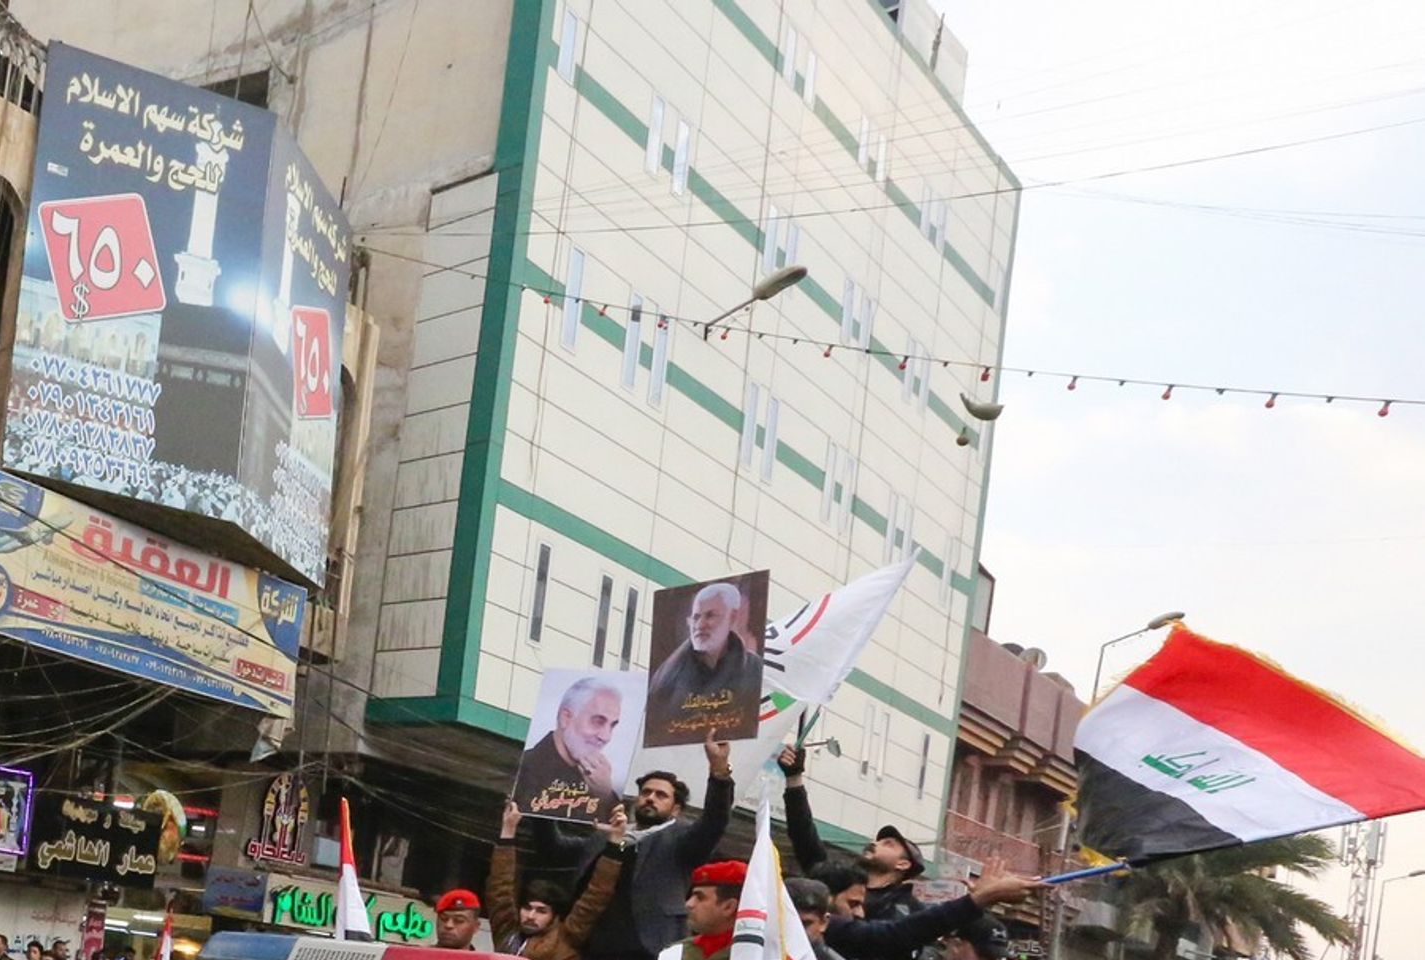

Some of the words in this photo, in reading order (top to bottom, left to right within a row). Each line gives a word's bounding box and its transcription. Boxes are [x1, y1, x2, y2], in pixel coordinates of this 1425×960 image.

[67, 72, 141, 117] الاسلام
[143, 103, 186, 132] سهم
[187, 103, 245, 152] شركة
[80, 120, 164, 182] والعمرة
[168, 158, 223, 192] للحج
[51, 211, 156, 291] ٦٥٠
[72, 281, 90, 322] $
[295, 315, 331, 396] ٦٥٠
[70, 515, 231, 599] العقيق
[38, 829, 111, 869] الهاشمي
[116, 845, 157, 876] عمار
[274, 885, 333, 928] الشام
[377, 902, 434, 942] مطعم
